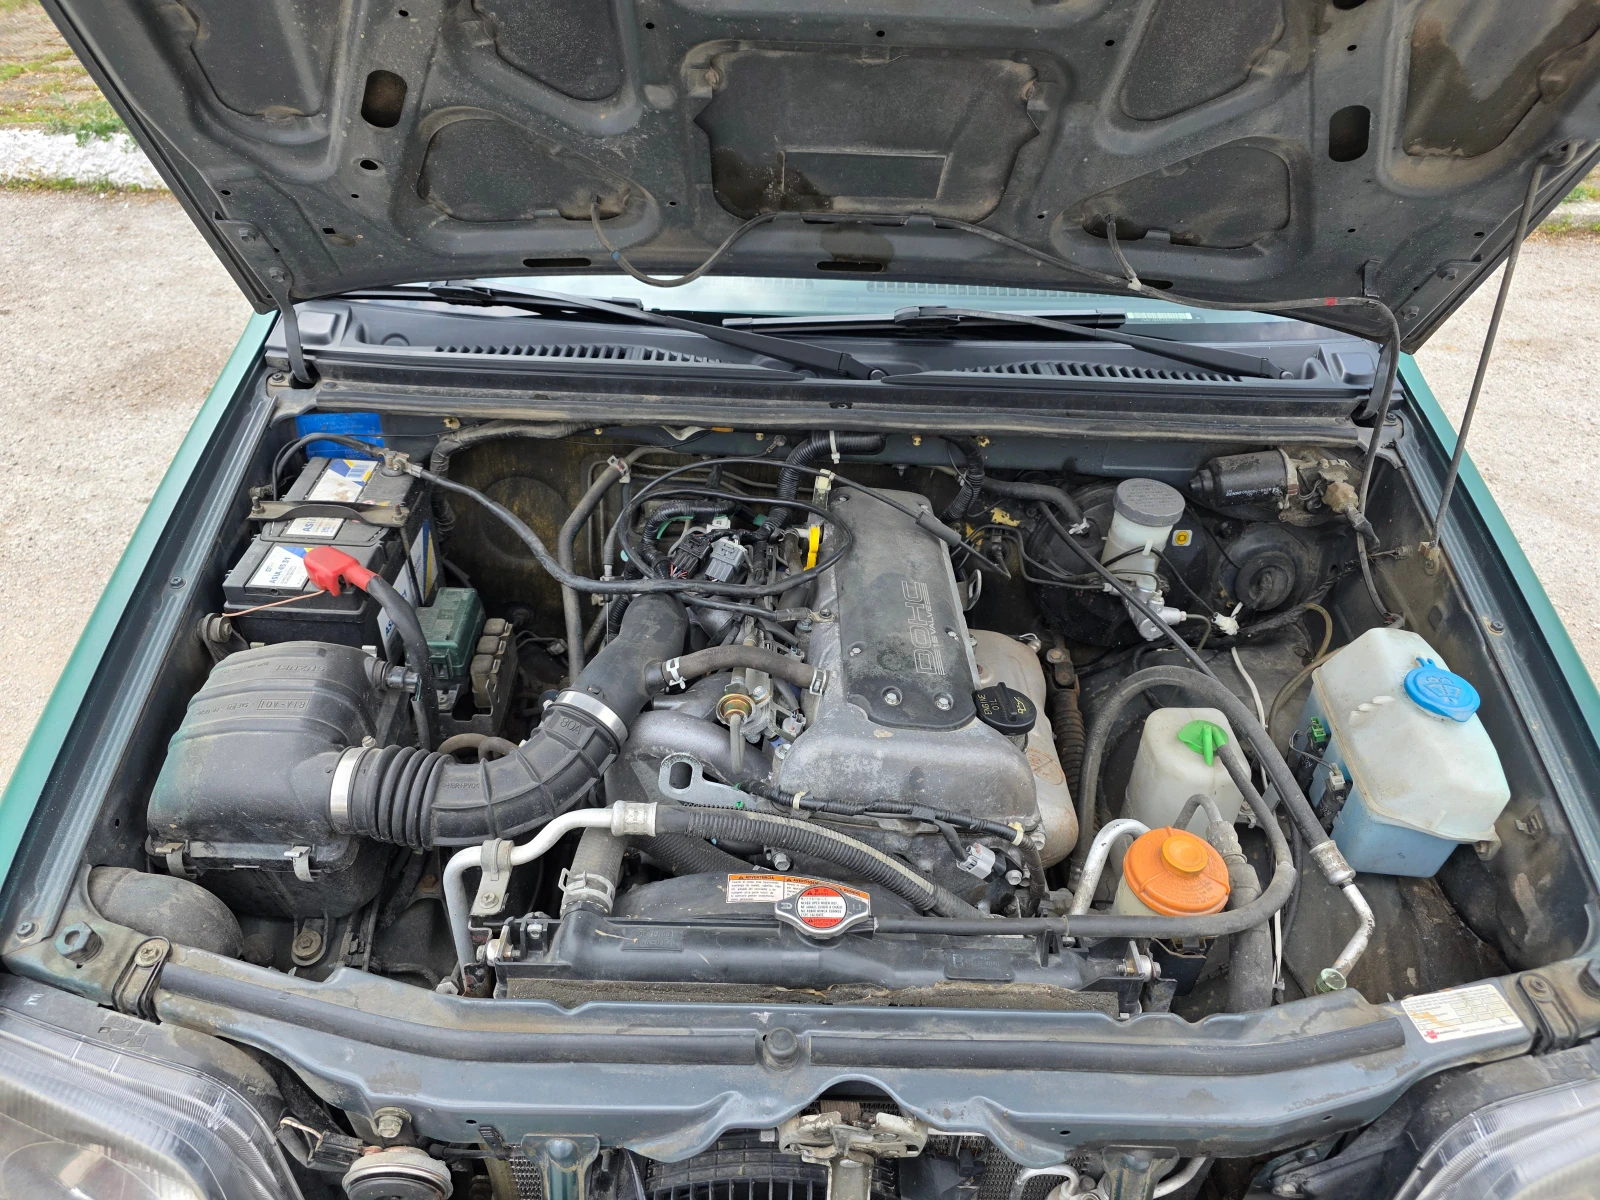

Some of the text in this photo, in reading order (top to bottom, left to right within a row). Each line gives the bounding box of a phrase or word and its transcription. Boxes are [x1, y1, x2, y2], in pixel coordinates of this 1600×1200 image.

[901, 581, 937, 675] DOHC
[276, 664, 327, 672] SUZUKI
[977, 694, 993, 715] ENGINE
[989, 698, 1000, 710] OIL
[560, 717, 582, 735] 80A
